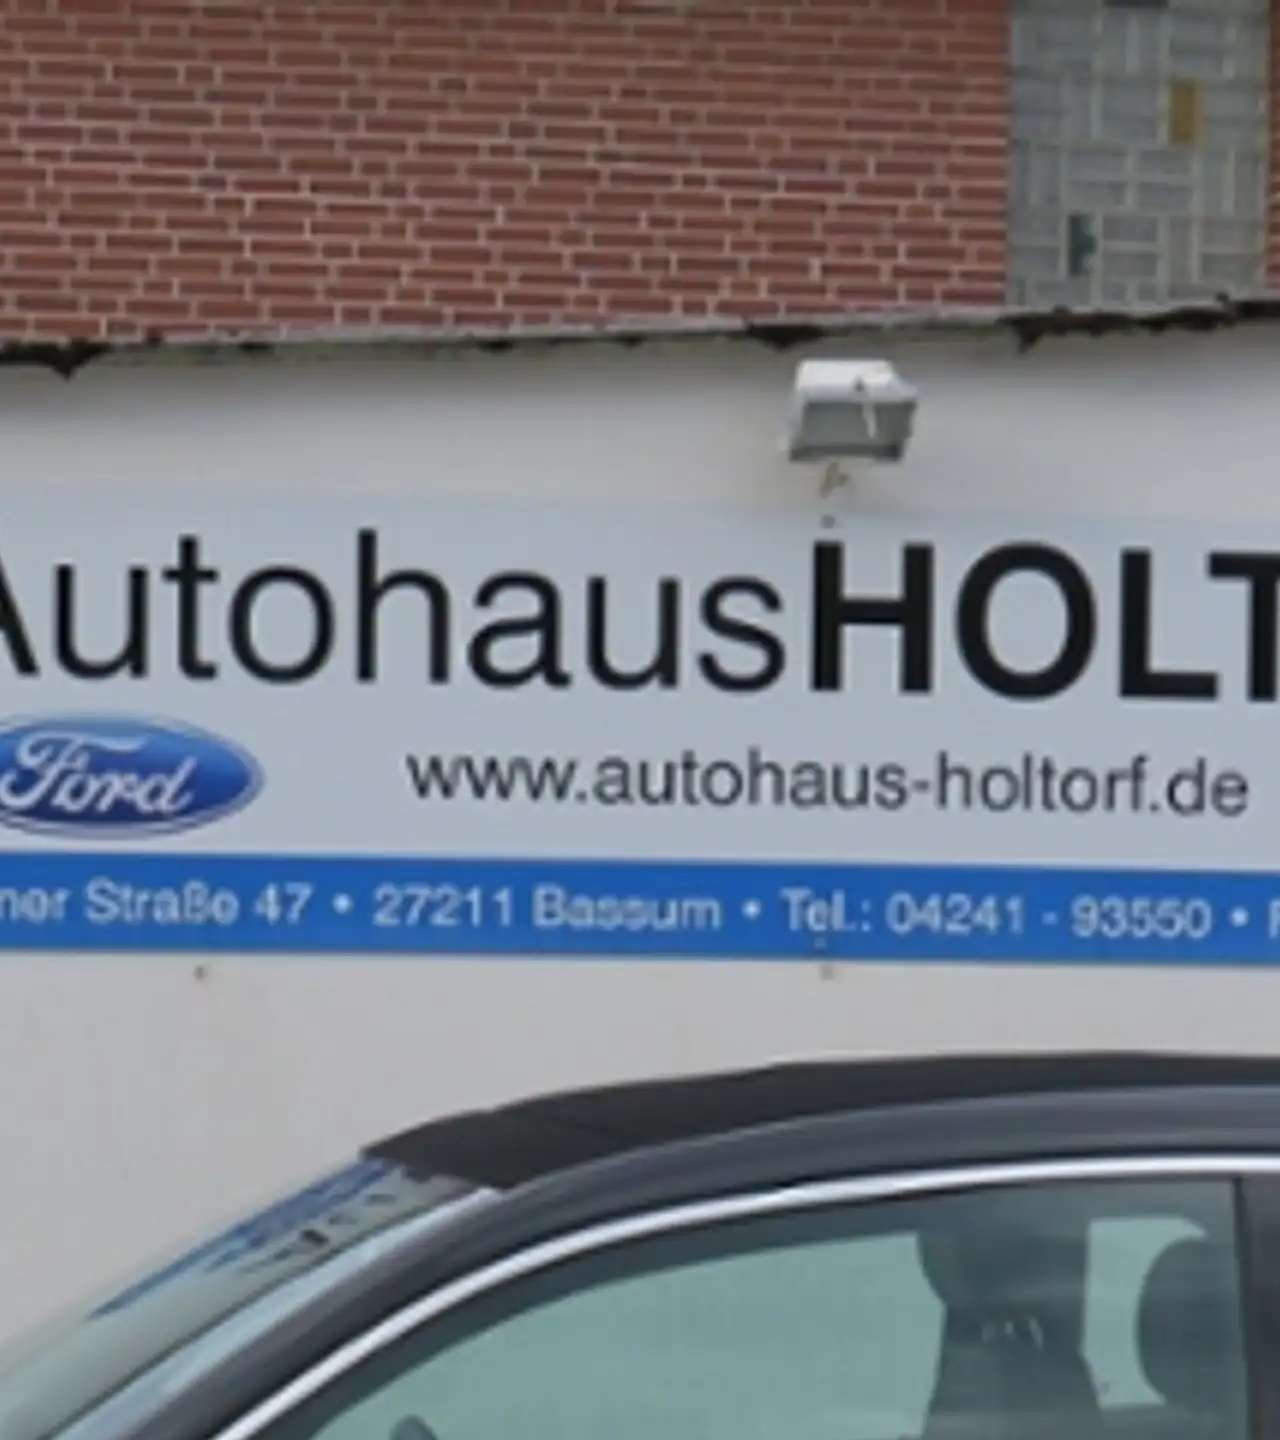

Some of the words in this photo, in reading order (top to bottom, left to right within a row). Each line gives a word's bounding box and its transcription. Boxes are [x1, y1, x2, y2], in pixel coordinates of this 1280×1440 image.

[406, 747, 1249, 817] www.autohaus-holtorf.de
[84, 876, 240, 925] Straße
[253, 882, 314, 926] 47
[373, 883, 512, 928] 27211
[533, 884, 720, 931] Bassum
[885, 893, 1024, 935] 04241
[1071, 896, 1212, 939] 93550
